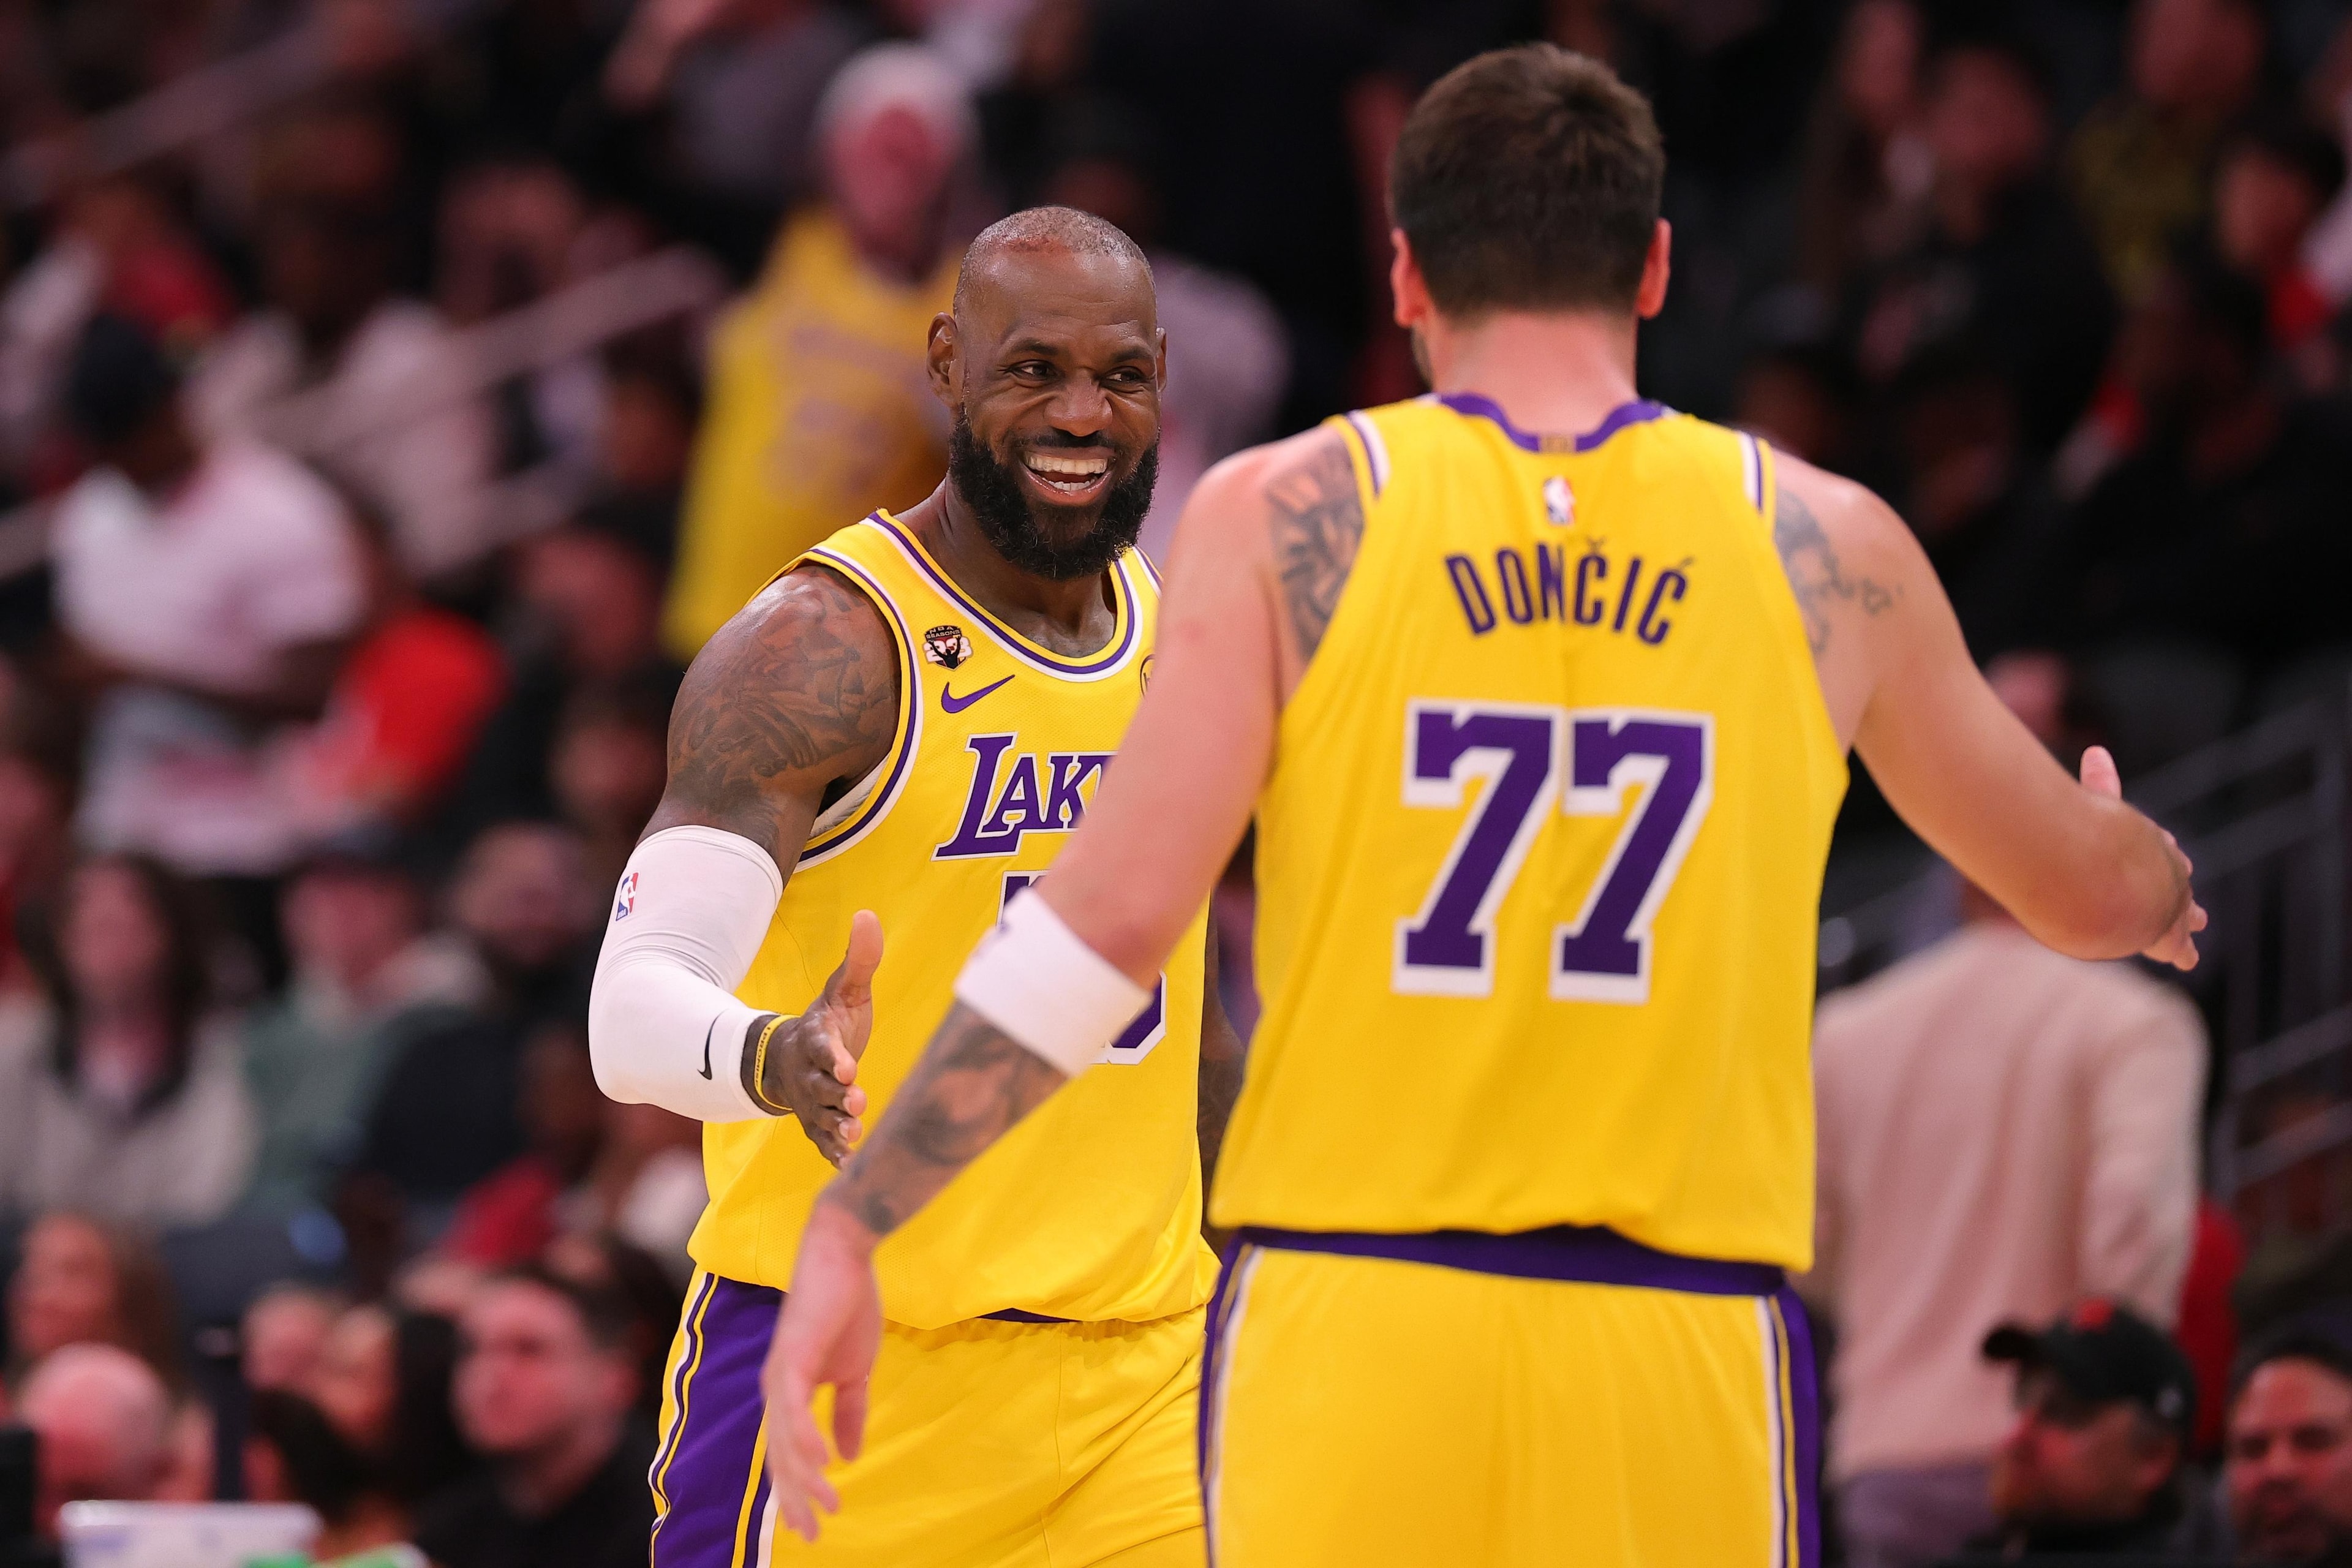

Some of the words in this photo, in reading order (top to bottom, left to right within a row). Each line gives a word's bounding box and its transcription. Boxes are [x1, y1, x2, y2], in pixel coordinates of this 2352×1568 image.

[925, 630, 960, 639] SEASONS
[1446, 538, 1694, 645] DONČIĆ
[930, 731, 1118, 861] LAK
[1390, 696, 1714, 1005] 77
